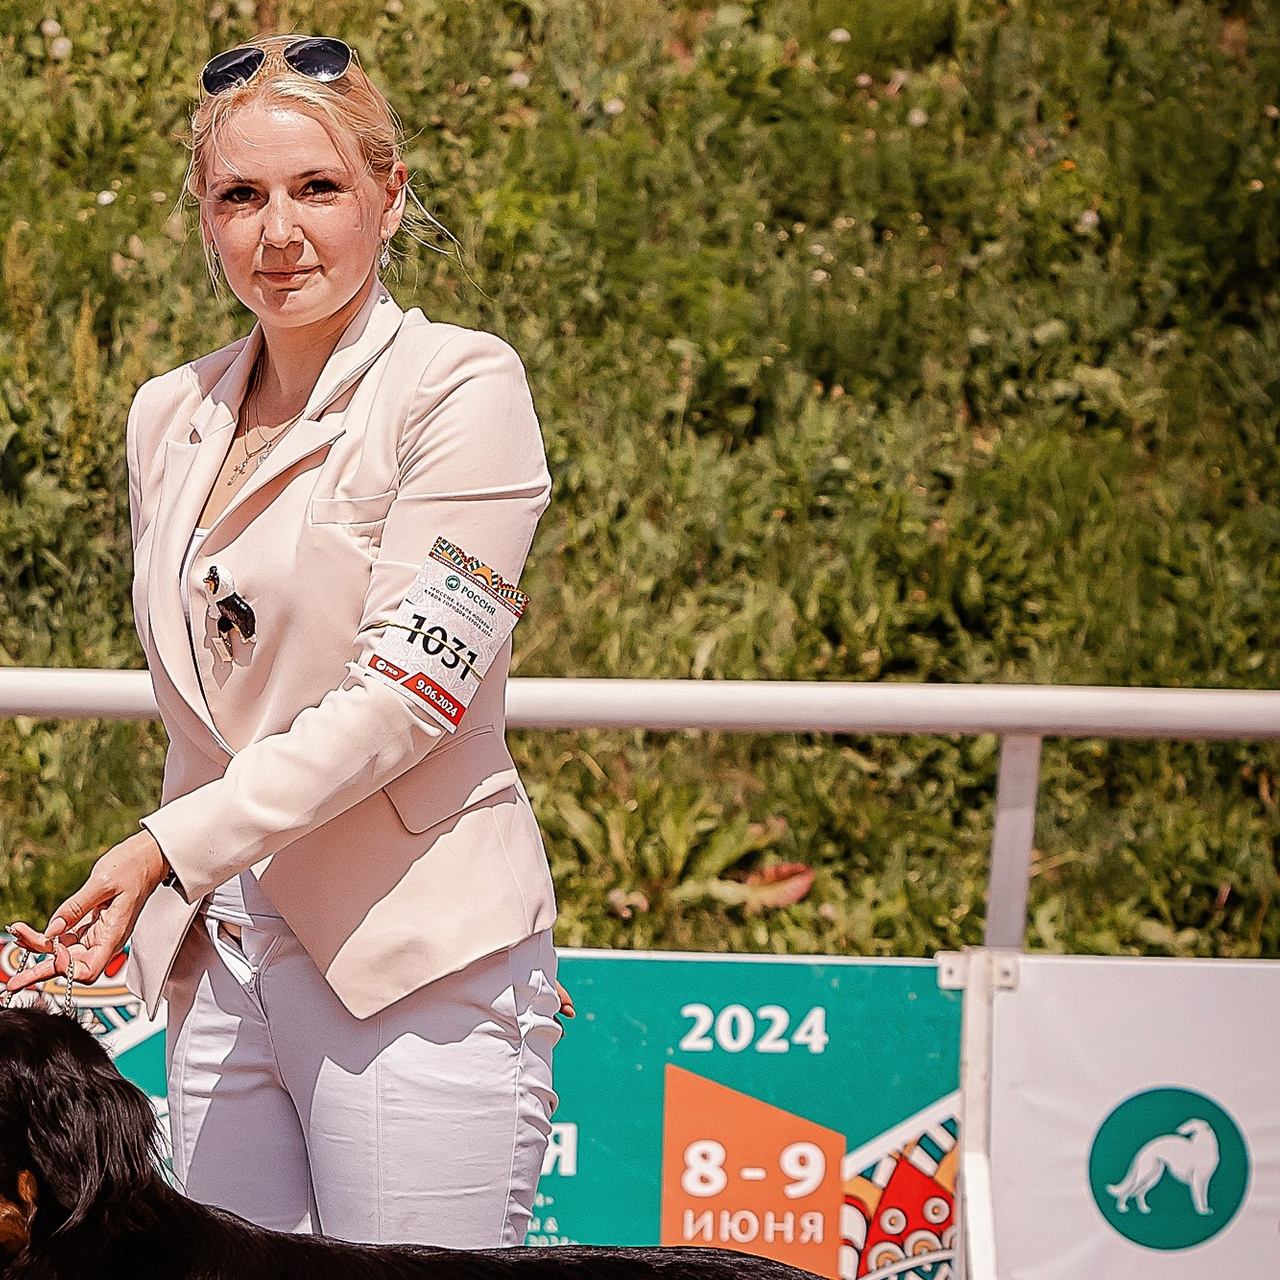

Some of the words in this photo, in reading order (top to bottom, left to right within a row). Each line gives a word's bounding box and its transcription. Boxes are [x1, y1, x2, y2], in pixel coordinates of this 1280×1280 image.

[460, 585, 497, 616] РОССИЯ
[407, 613, 478, 681] 1031
[415, 678, 459, 718] 9.06.2024
[680, 1003, 830, 1054] 2024
[683, 1209, 825, 1245] ИЮНЯ
